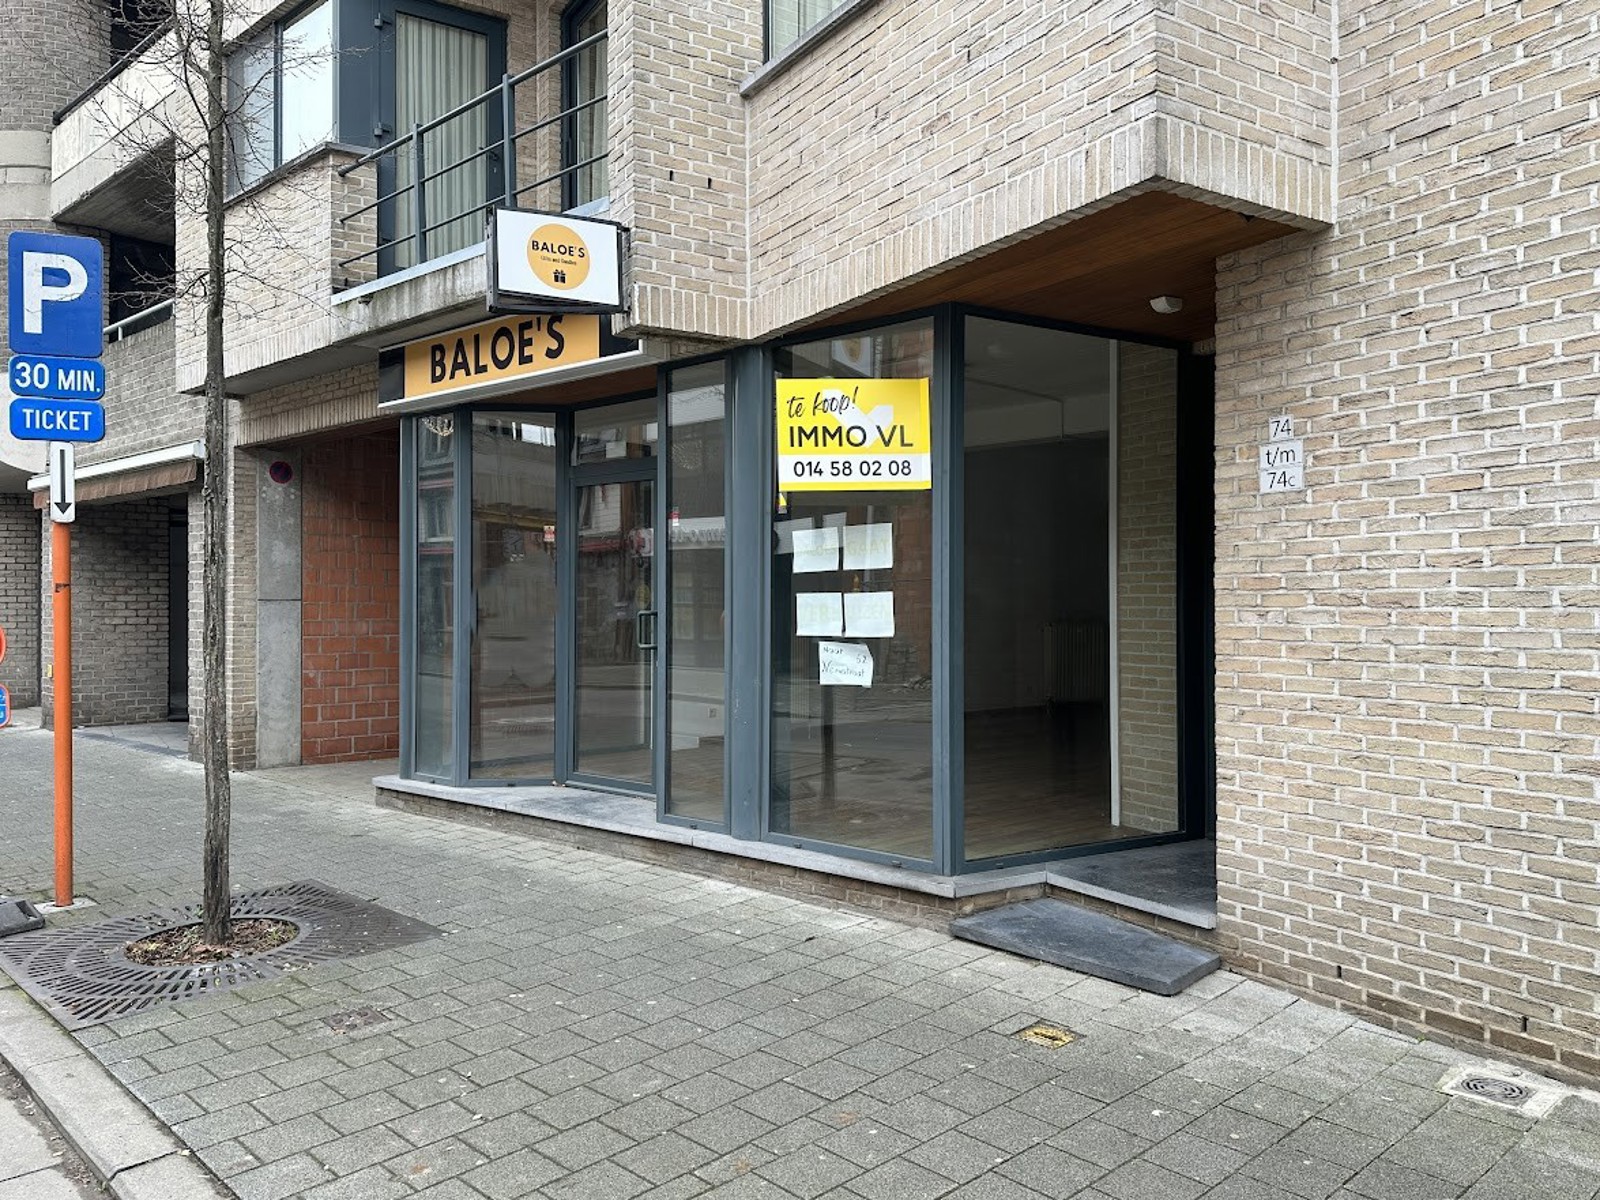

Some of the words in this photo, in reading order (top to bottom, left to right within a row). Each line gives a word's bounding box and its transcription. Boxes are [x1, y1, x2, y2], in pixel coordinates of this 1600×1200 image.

[531, 239, 585, 259] BALOE'S
[22, 251, 88, 335] P
[430, 315, 565, 384] BALOE'S
[14, 362, 50, 390] 30
[57, 368, 101, 393] MIN.
[786, 396, 806, 419] te
[812, 386, 860, 417] koop!
[22, 408, 92, 431] TICKET
[1270, 418, 1292, 438] 74
[789, 424, 868, 448] IMMO
[875, 424, 914, 448] VL
[1265, 447, 1296, 467] t/m
[793, 460, 824, 478] 014
[830, 460, 853, 477] 58
[859, 460, 882, 477] 02
[888, 460, 912, 477] 08
[1267, 470, 1297, 489] 74c
